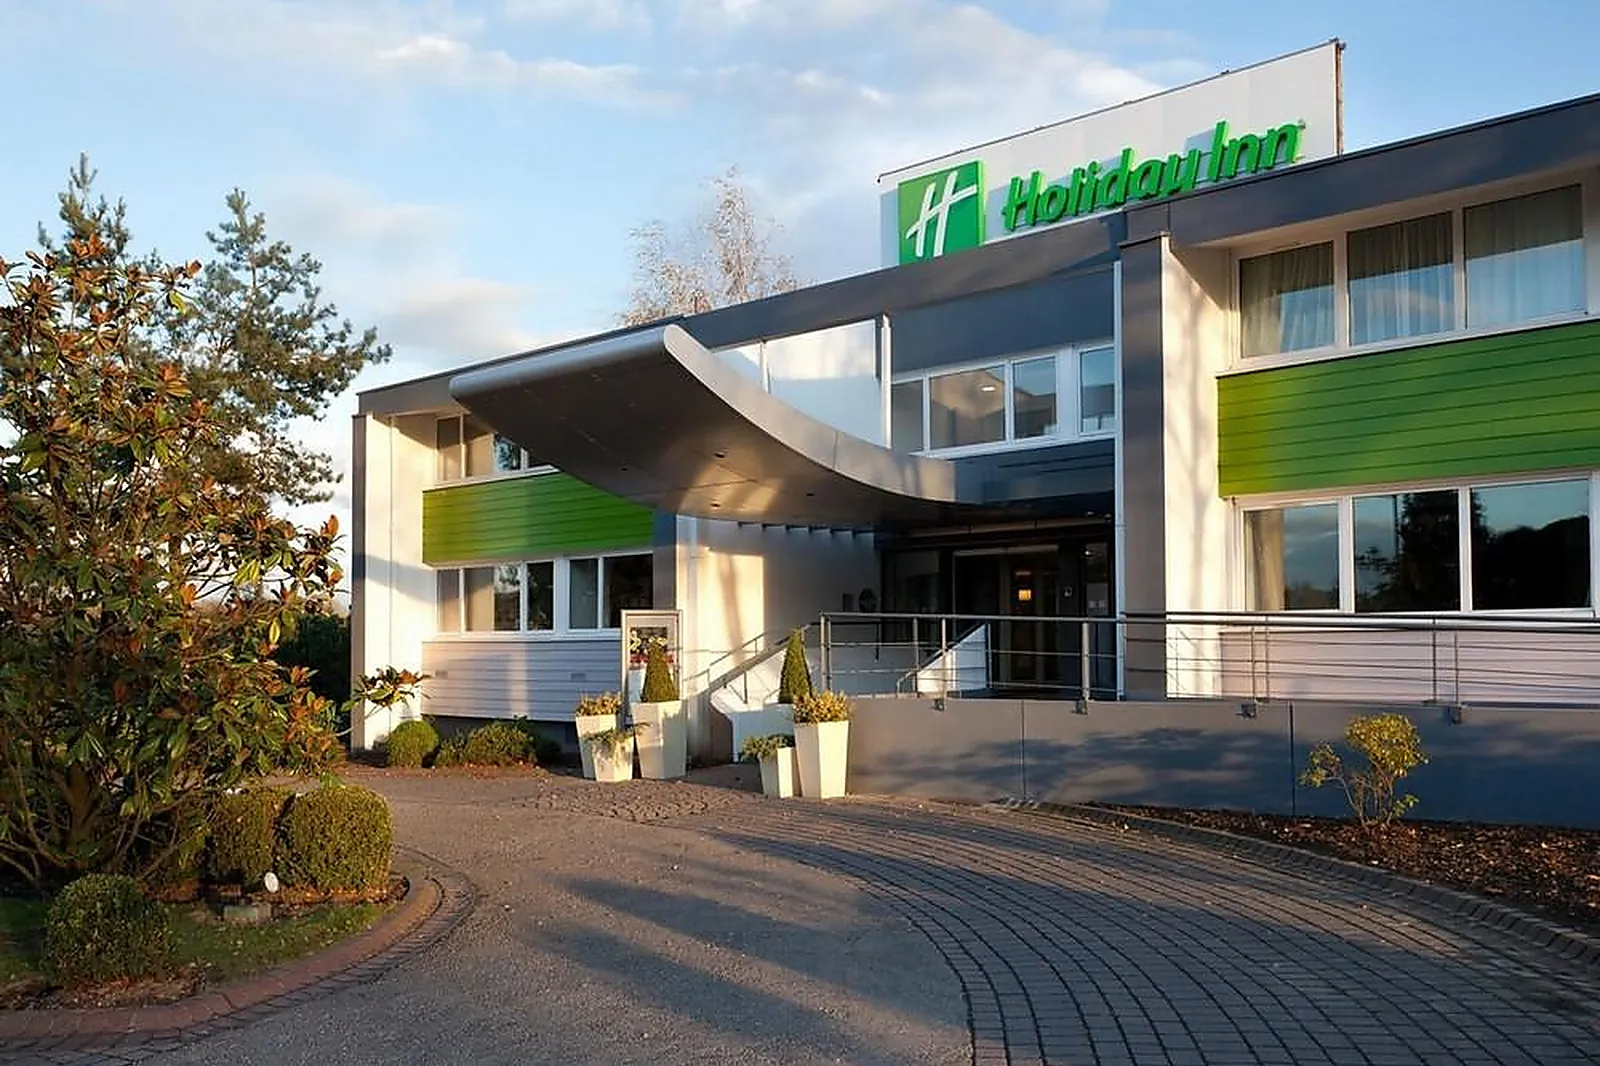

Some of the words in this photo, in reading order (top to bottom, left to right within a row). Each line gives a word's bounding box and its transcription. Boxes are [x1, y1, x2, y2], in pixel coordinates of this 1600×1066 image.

[906, 169, 977, 258] H
[1002, 147, 1201, 231] Holiday
[1206, 120, 1301, 182] Inn
